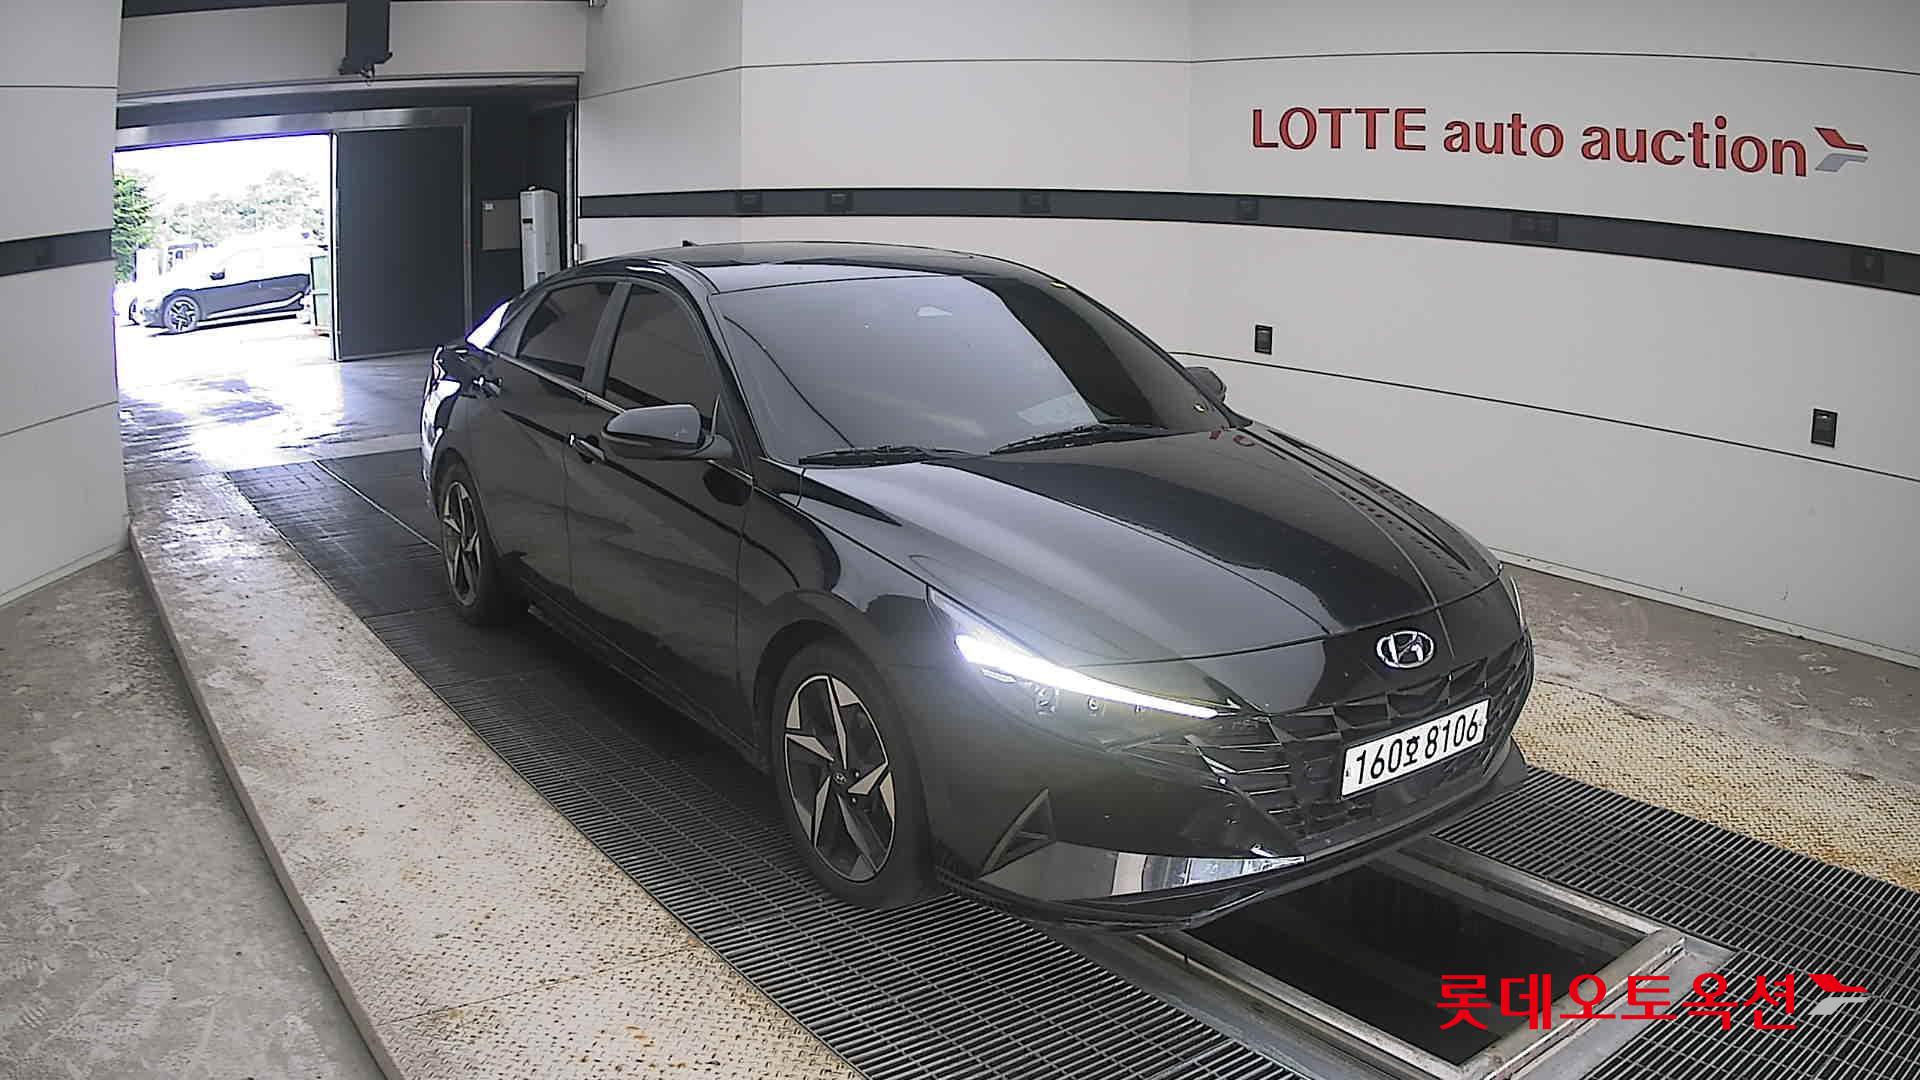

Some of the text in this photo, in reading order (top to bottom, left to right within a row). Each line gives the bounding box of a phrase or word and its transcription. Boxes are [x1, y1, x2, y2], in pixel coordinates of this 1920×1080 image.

[1252, 107, 1808, 178] LOTTE auto auction
